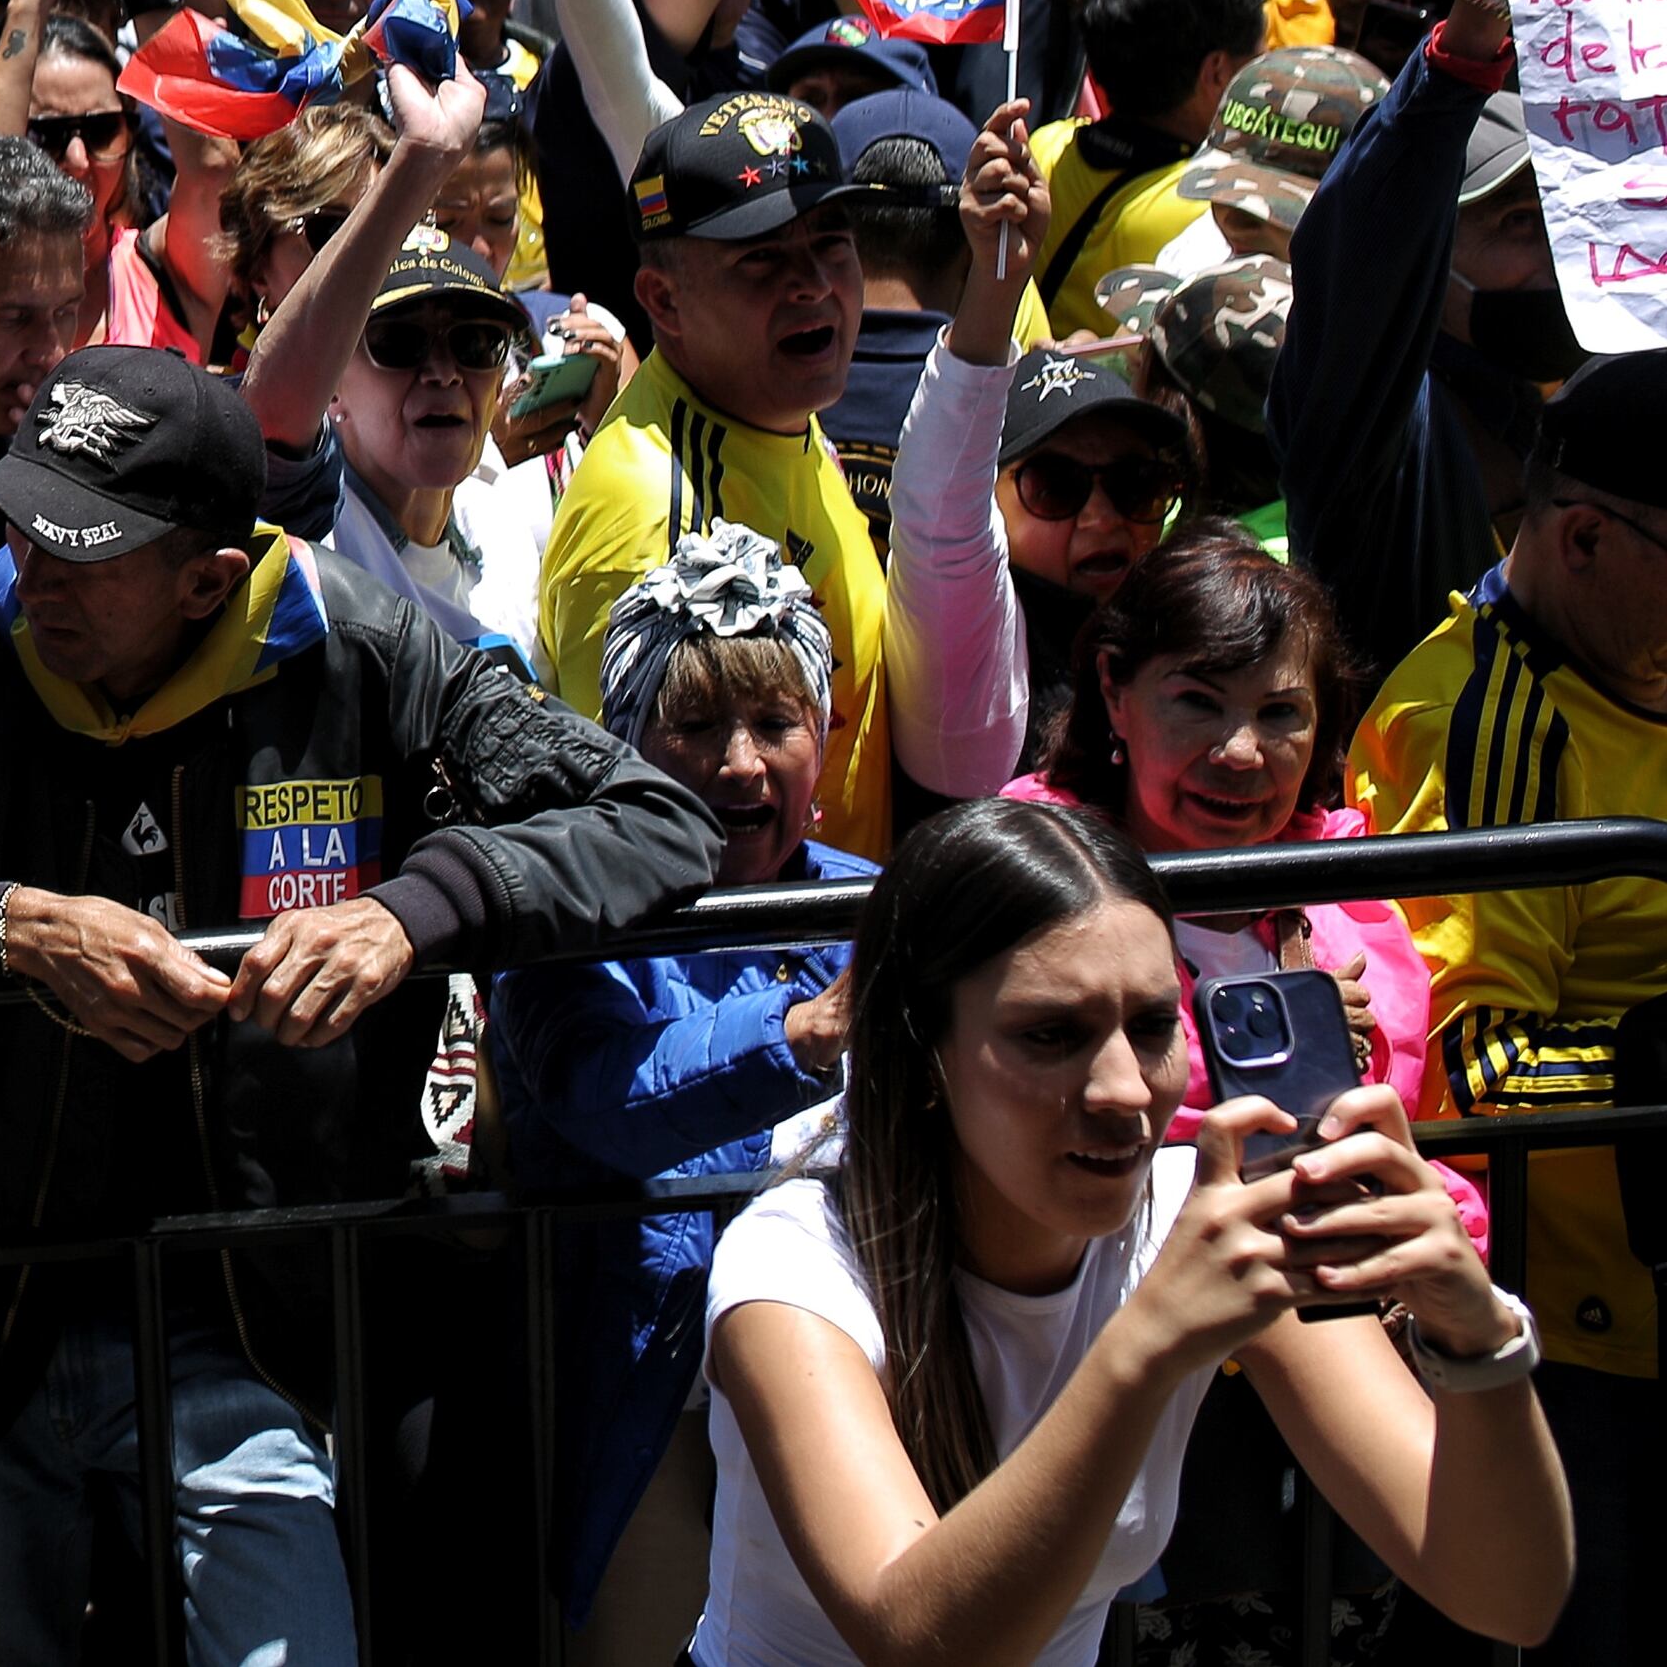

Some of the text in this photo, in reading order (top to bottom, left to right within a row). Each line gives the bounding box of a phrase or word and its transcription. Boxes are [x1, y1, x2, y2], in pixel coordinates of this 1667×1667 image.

[1221, 99, 1341, 153] USCÁTEGUI
[31, 512, 123, 548] NAVY SEAL
[243, 780, 364, 827] RESPETO
[268, 826, 348, 872] A LA
[267, 871, 348, 912] CORTE
